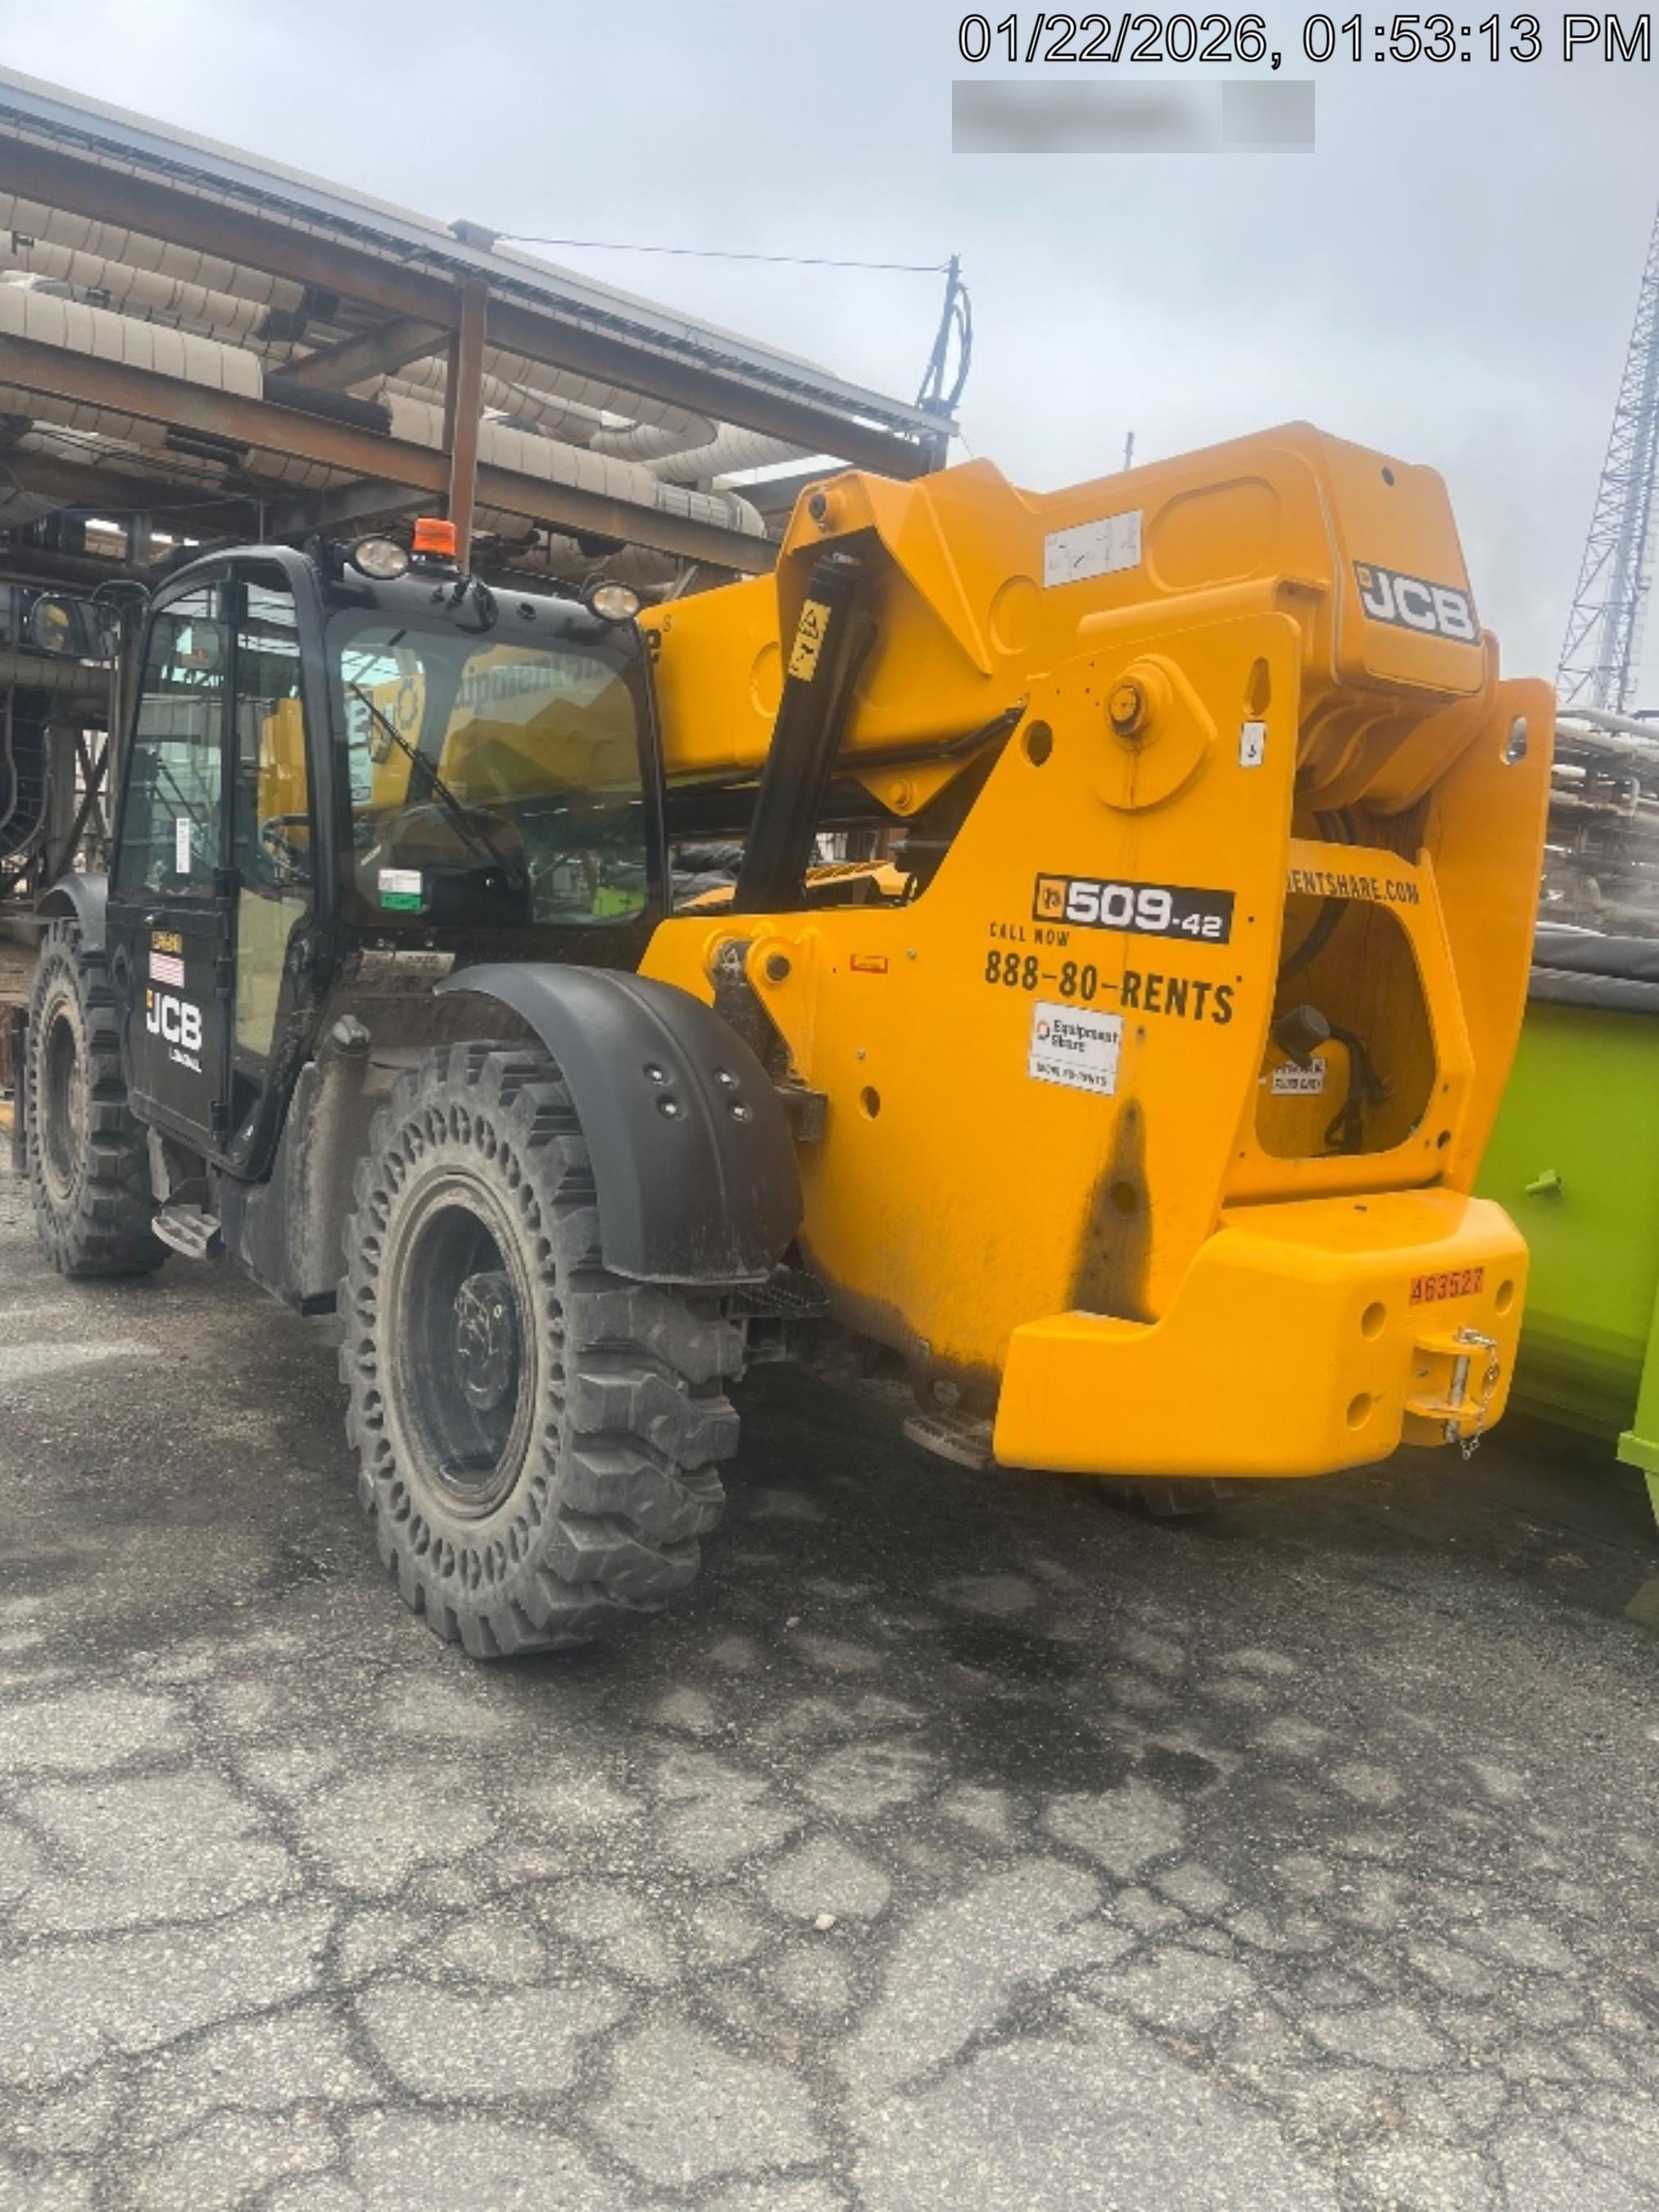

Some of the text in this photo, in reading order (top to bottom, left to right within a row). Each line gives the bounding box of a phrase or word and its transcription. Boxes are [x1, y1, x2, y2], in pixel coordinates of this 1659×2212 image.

[1362, 572, 1475, 640] JCB
[989, 922, 1071, 946] CALL NOW
[1066, 882, 1223, 938] 509-42
[985, 950, 1235, 1025] 888-80-RENTS
[146, 991, 203, 1051] JCB
[1410, 1267, 1484, 1303] 463527
